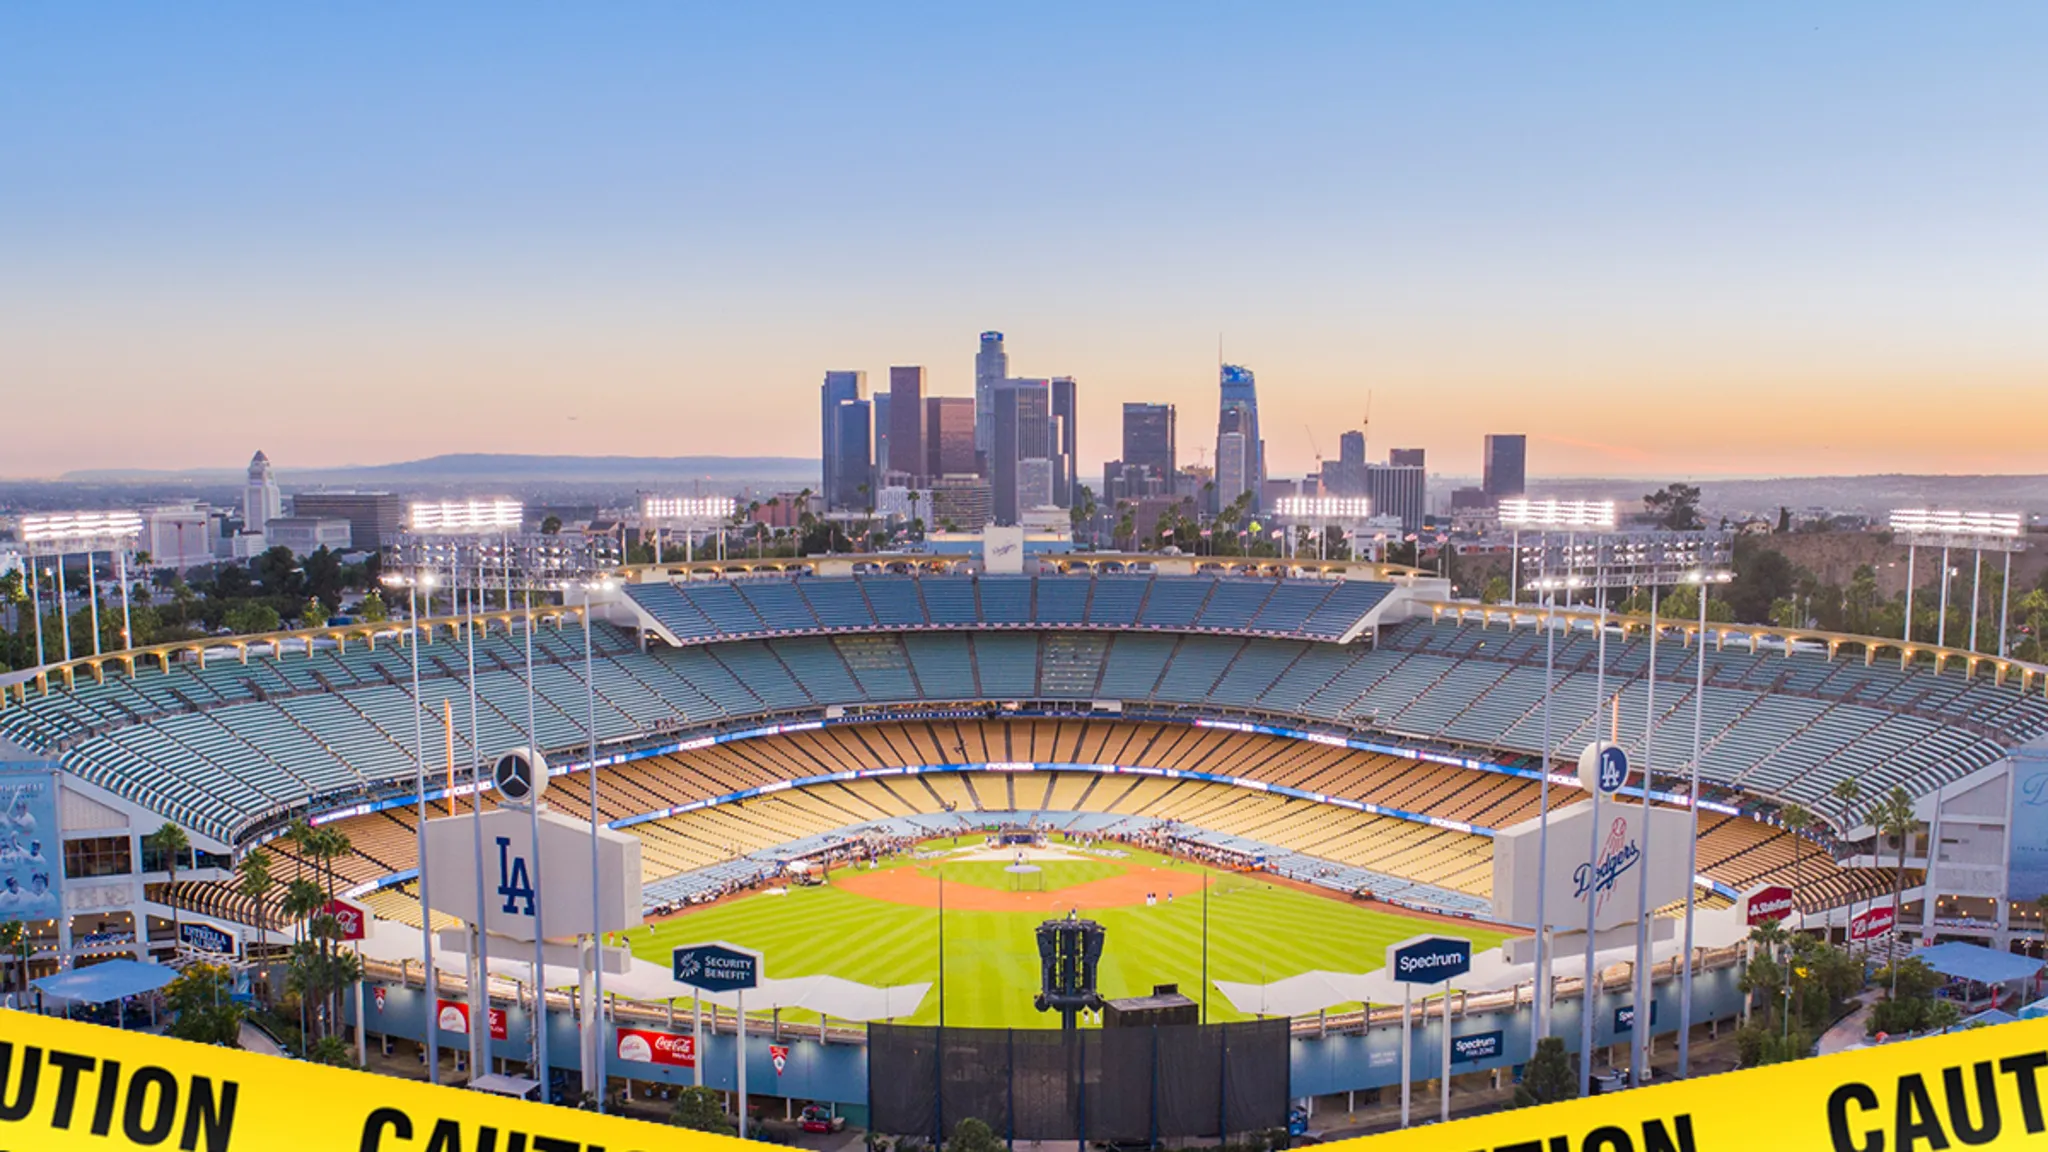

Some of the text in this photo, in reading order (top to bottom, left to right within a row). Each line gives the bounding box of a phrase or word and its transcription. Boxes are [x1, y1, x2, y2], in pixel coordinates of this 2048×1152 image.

[1602, 753, 1620, 787] LA
[496, 836, 535, 916] LA
[704, 955, 752, 969] SECURITY
[1400, 952, 1462, 972] Spectrum
[704, 968, 746, 980] BENEFIT
[1456, 1037, 1496, 1053] Spectrum
